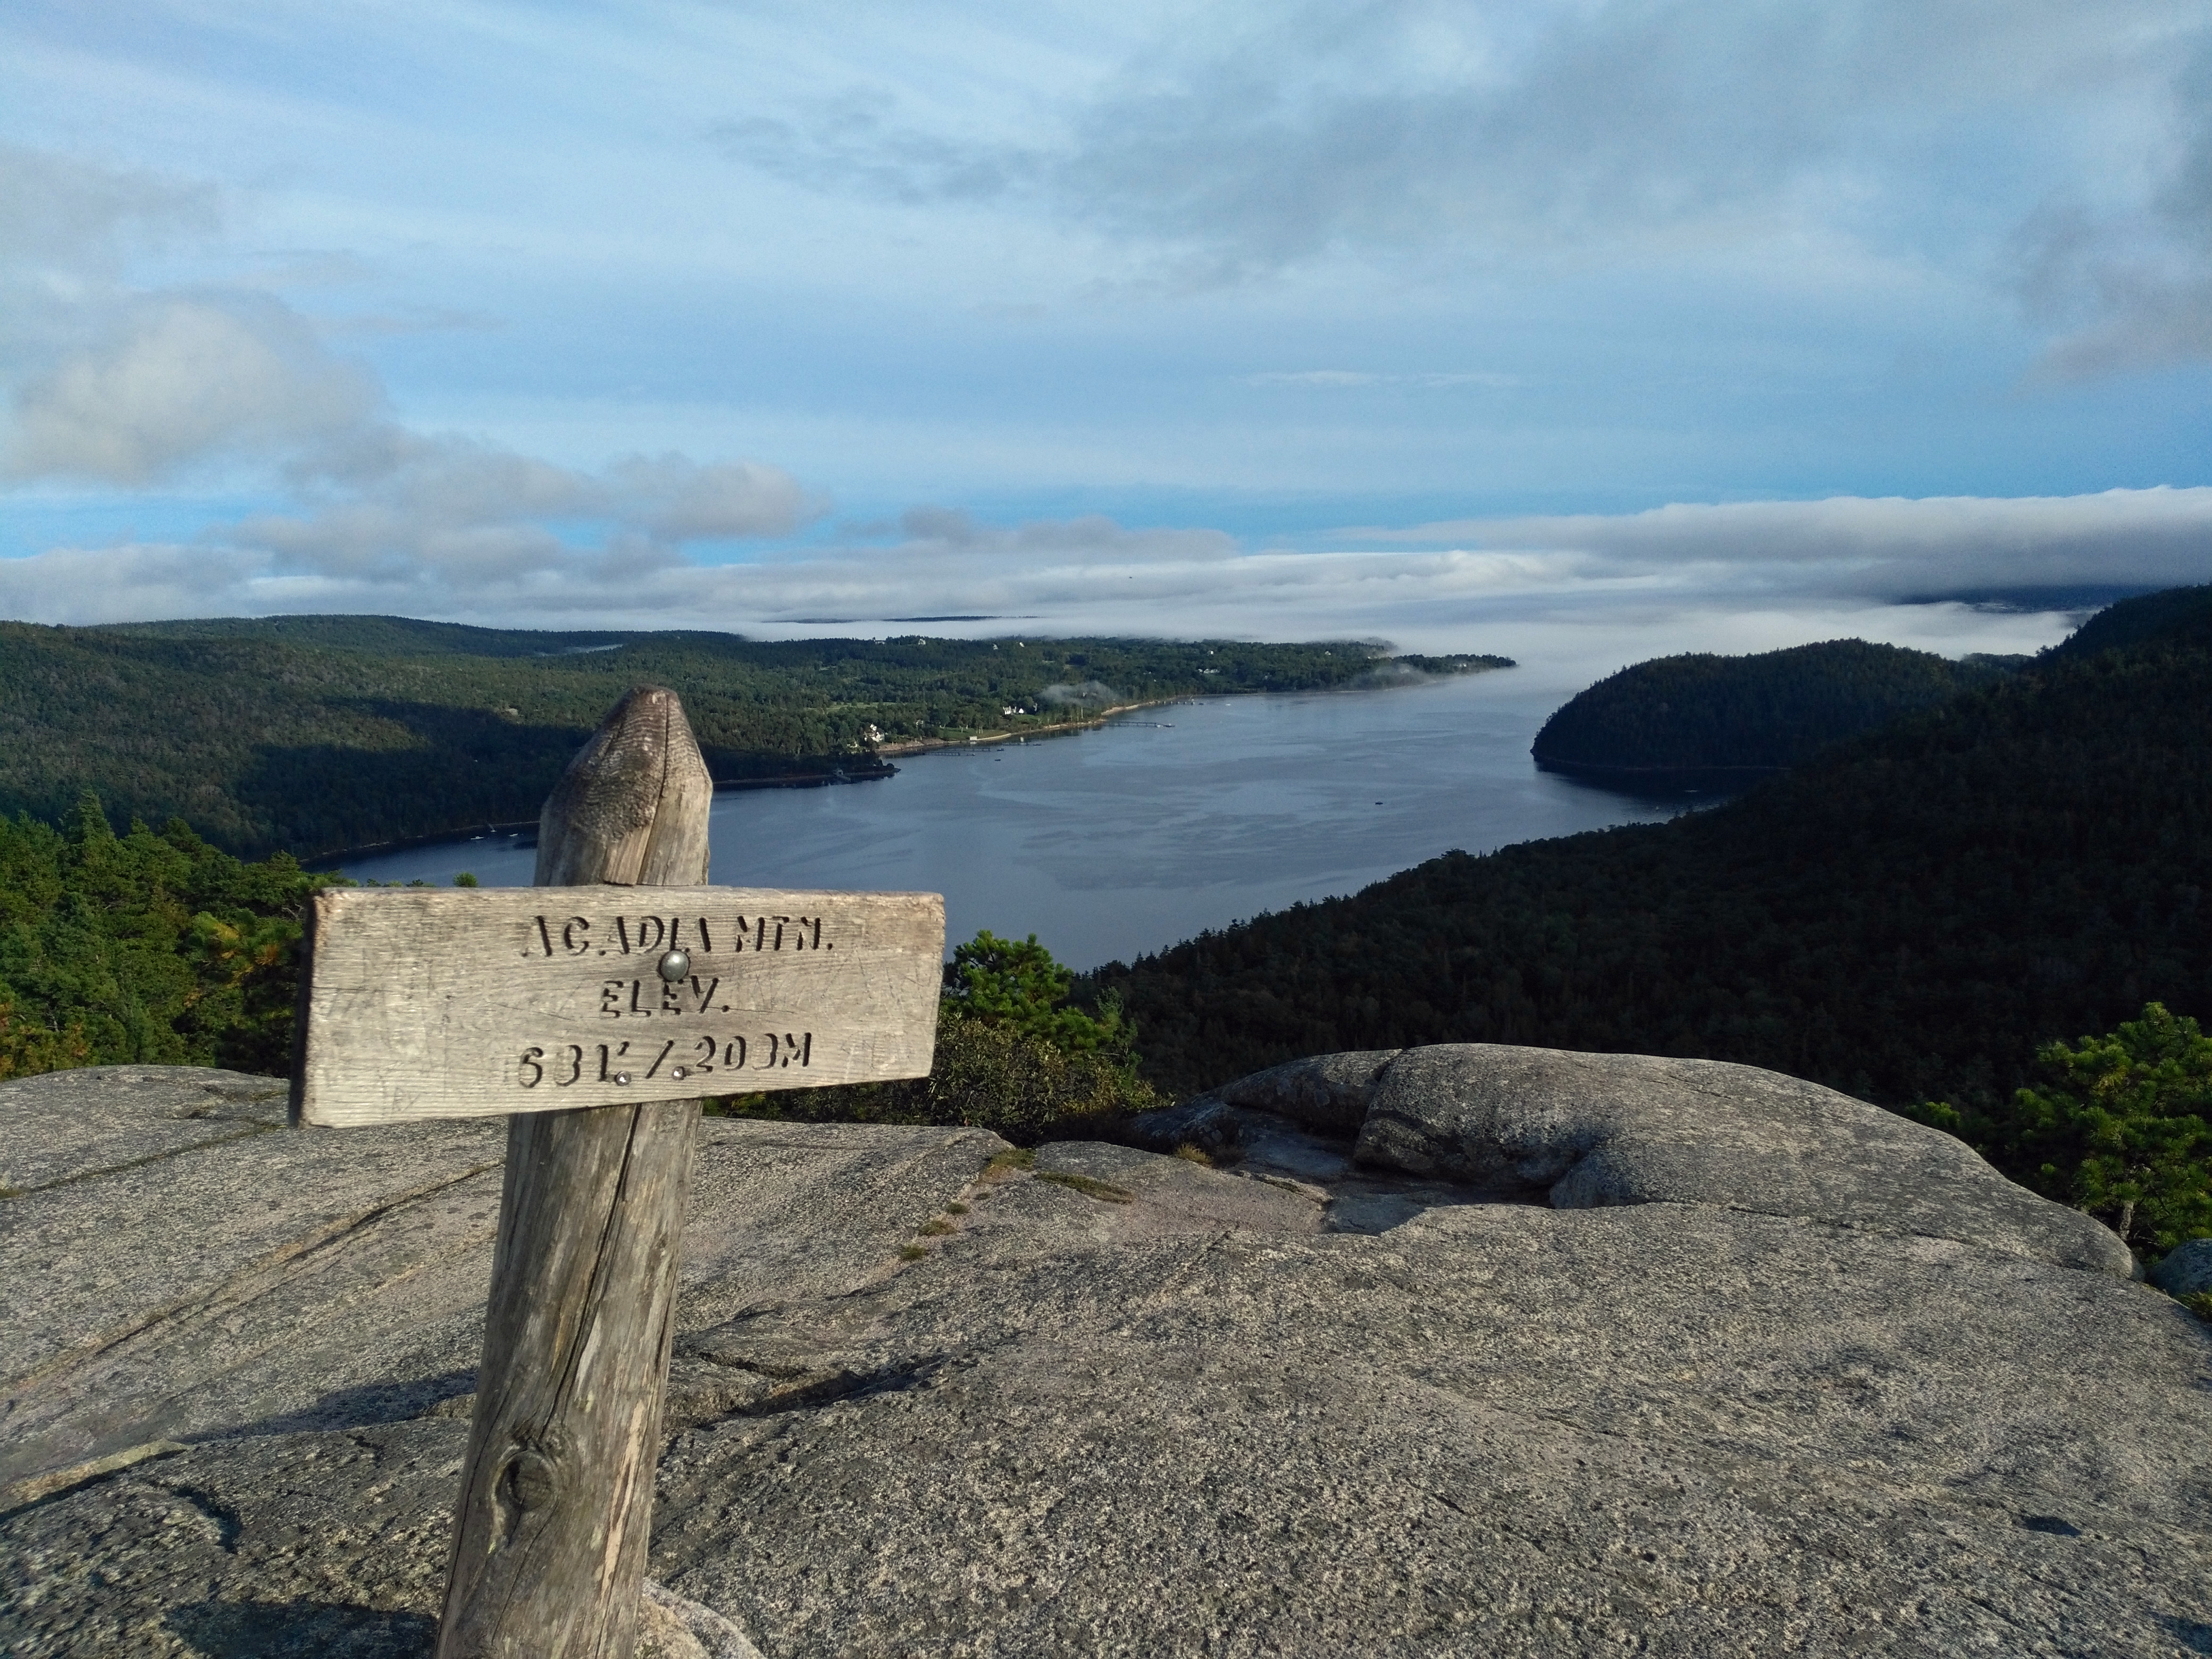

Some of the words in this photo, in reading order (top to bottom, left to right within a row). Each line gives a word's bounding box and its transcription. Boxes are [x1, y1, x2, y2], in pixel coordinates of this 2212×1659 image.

[518, 913, 713, 957] ACADIA
[735, 914, 834, 953] MTN.
[600, 975, 727, 1018] ELEV.
